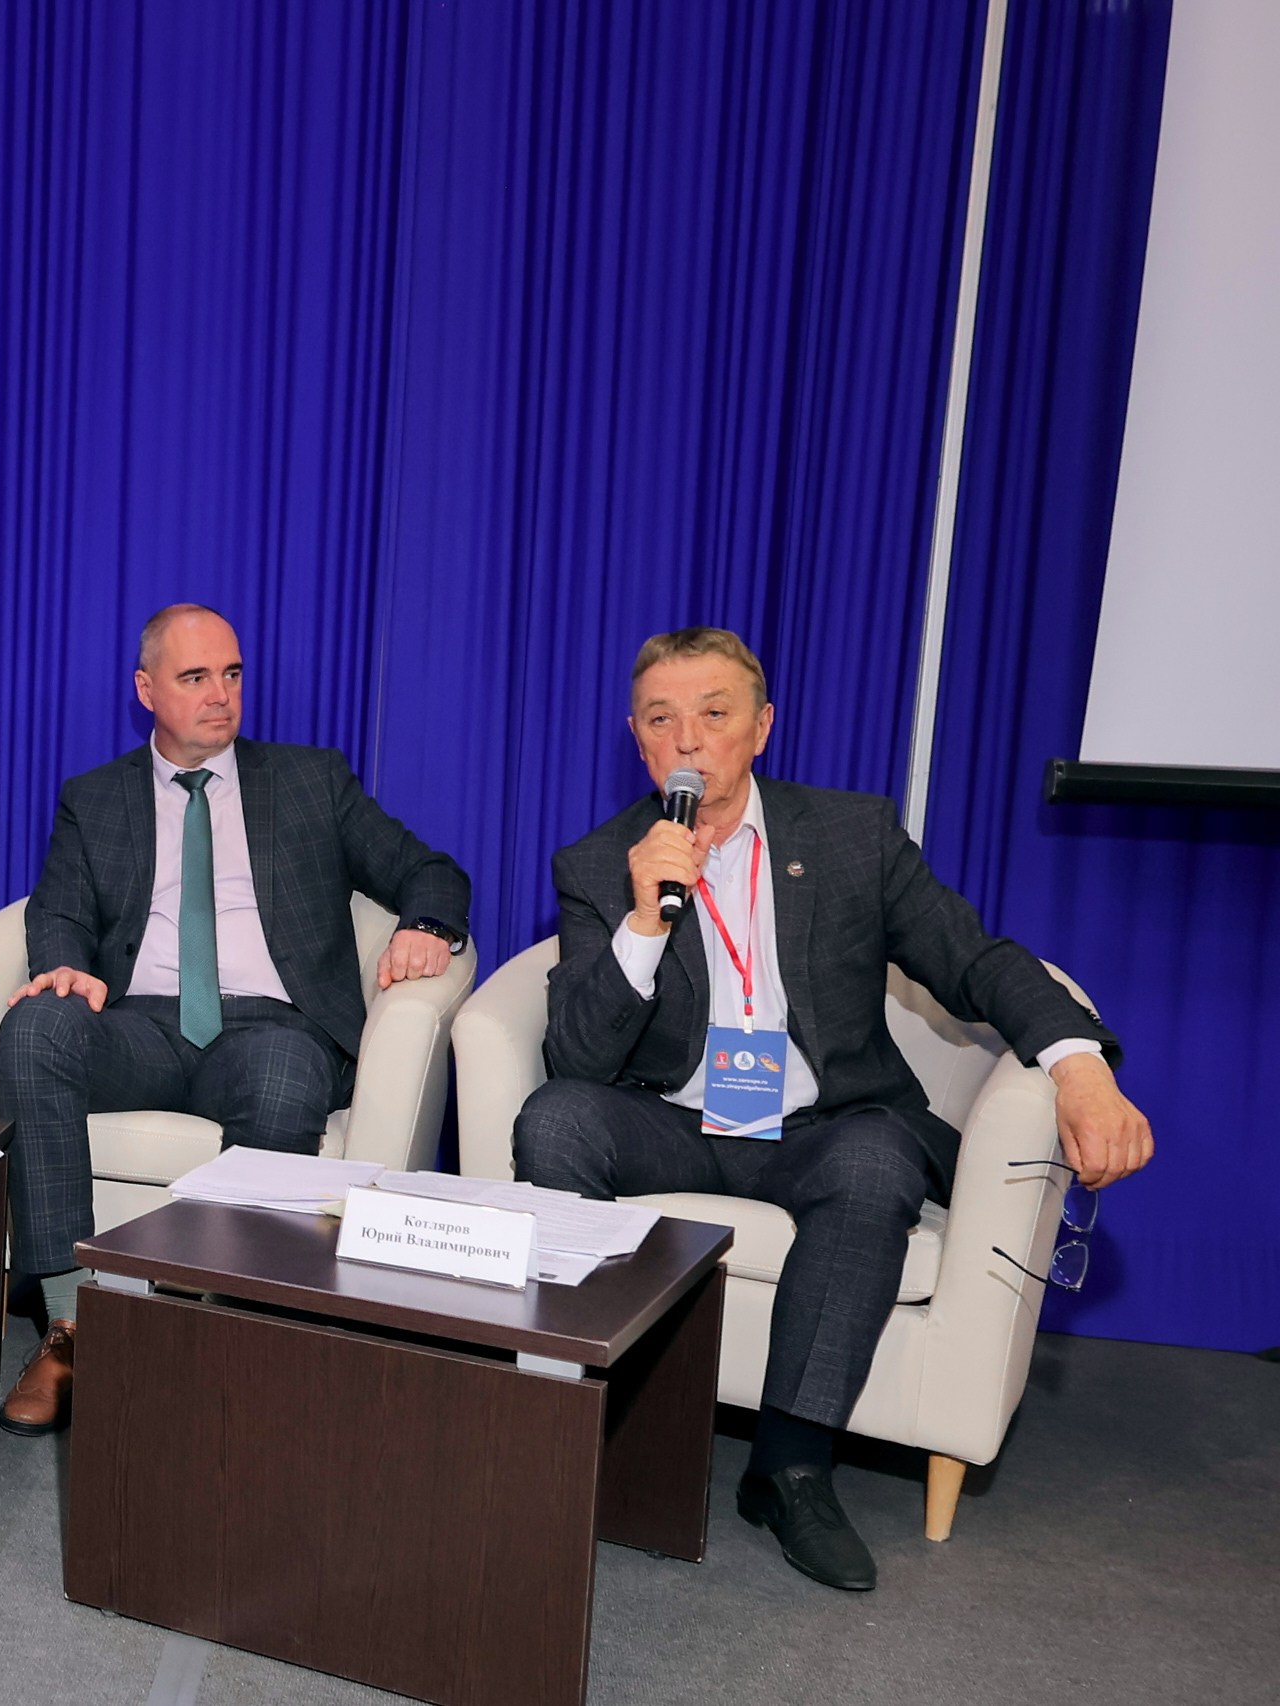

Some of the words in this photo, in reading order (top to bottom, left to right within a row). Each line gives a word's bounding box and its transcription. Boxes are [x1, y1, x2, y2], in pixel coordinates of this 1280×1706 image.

[404, 1214, 471, 1235] Котляров
[361, 1226, 402, 1244] Юрий
[406, 1233, 511, 1260] Владимирович
